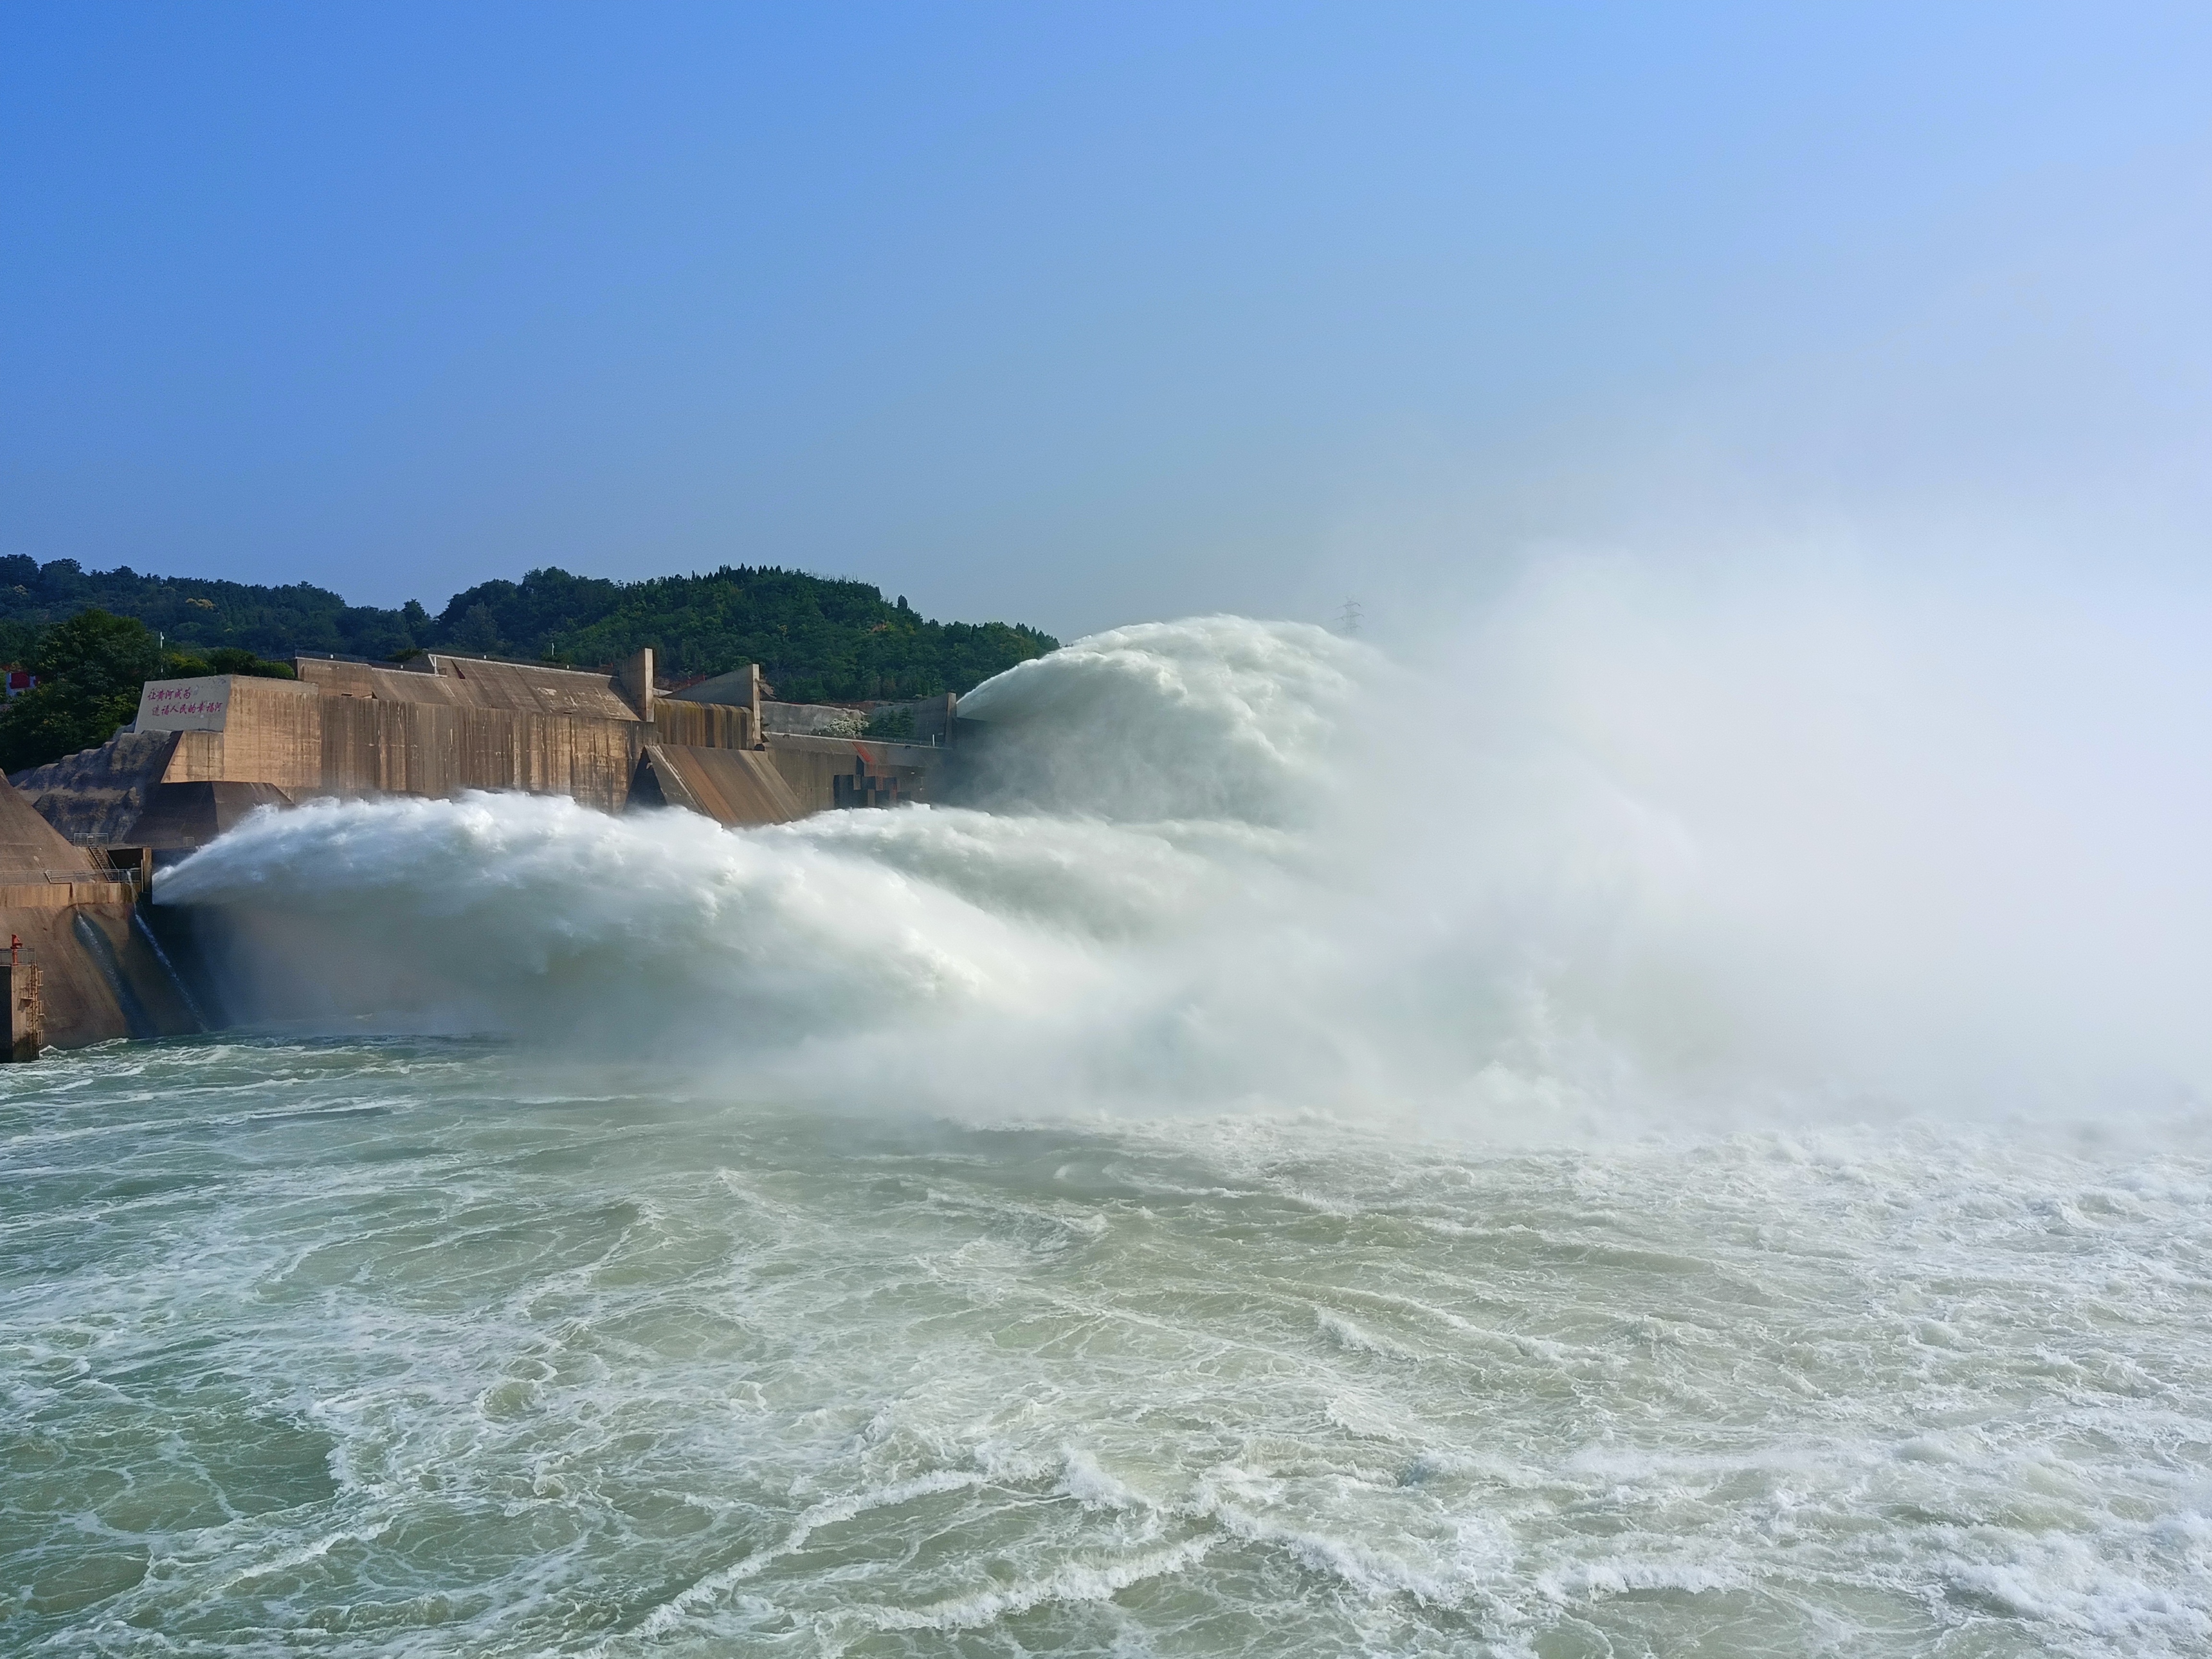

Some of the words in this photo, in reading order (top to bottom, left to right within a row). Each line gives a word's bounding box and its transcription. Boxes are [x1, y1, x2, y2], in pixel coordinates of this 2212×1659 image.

[147, 687, 191, 701] 让黄河成为
[152, 701, 223, 716] 造福人民的幸福河
